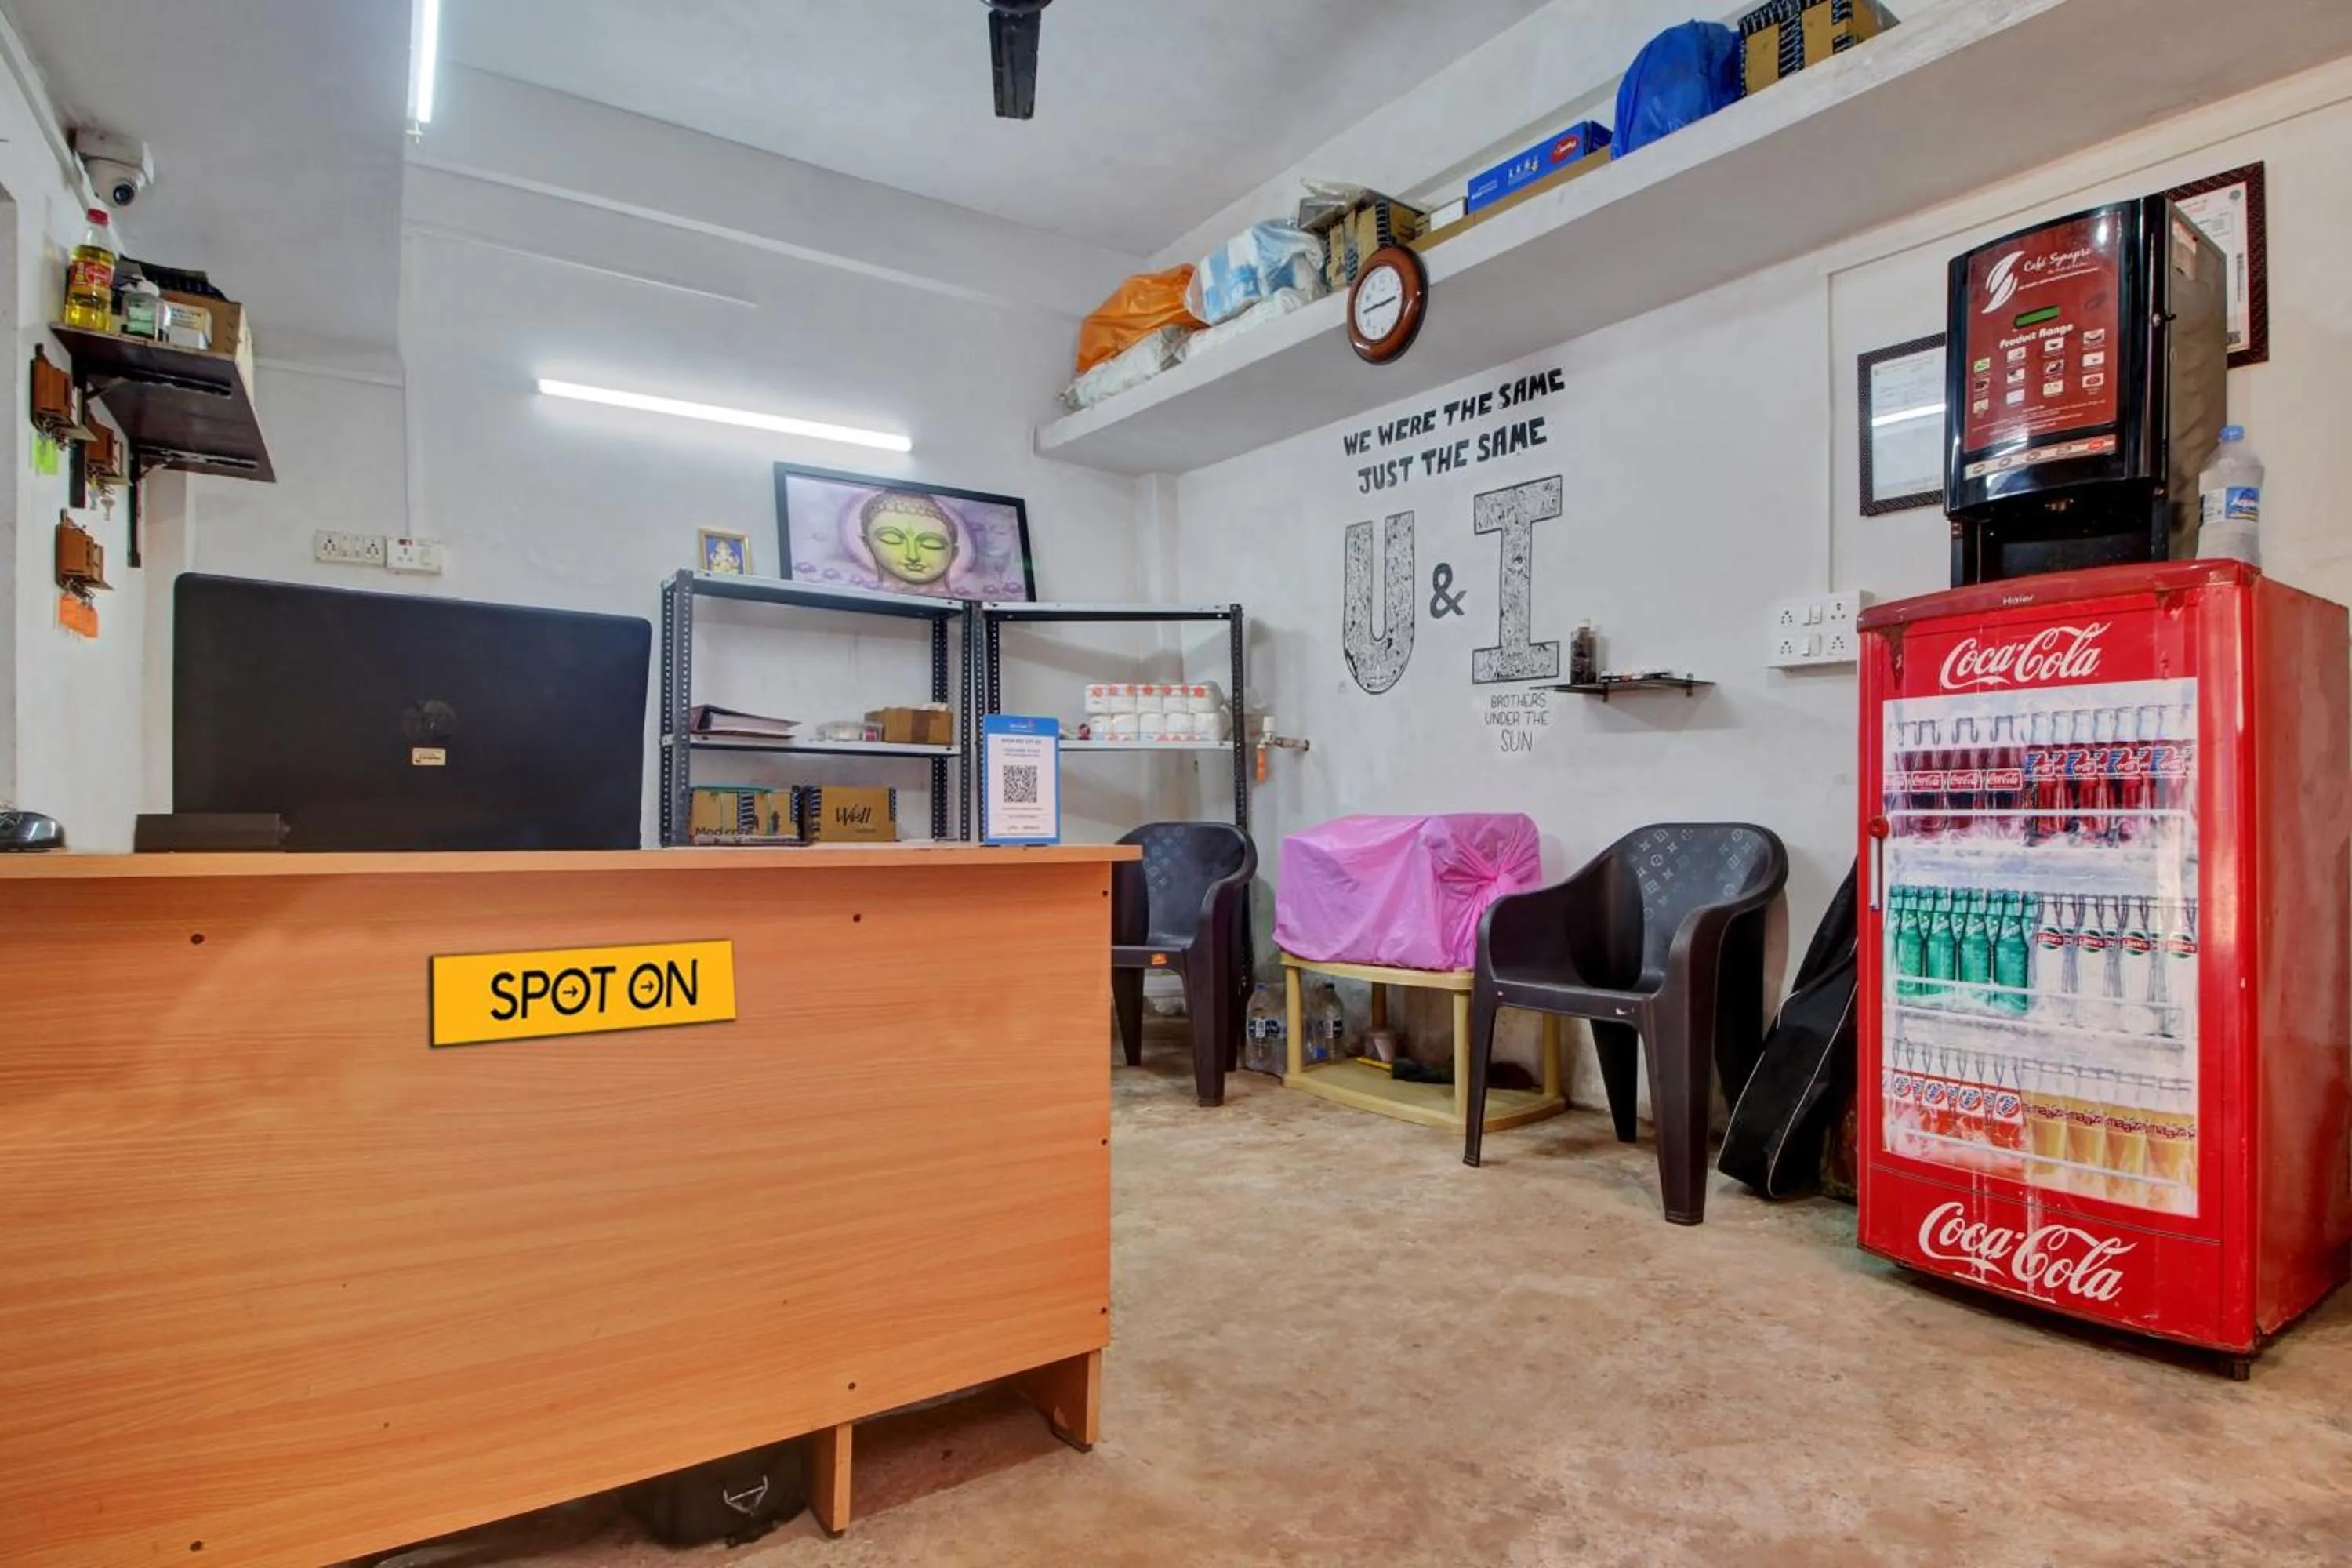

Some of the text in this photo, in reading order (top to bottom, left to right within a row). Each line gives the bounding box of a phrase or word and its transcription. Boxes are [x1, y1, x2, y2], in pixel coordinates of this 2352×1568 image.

[1999, 323, 2074, 350] Product Range
[1343, 368, 1566, 456] WE WERE THE SAME
[1357, 416, 1548, 495] JUST THE SAME
[1343, 474, 1563, 695] U & I
[2003, 594, 2035, 606] Haier
[1940, 621, 2113, 689] Coca-Cola
[1485, 710, 1549, 726] UNDER THE
[1491, 692, 1547, 709] BROTHERS
[1501, 729, 1533, 752] SUN
[835, 804, 872, 826] Well
[491, 958, 698, 1021] SPOT ON
[1918, 1201, 2139, 1301] Coca-Cola
